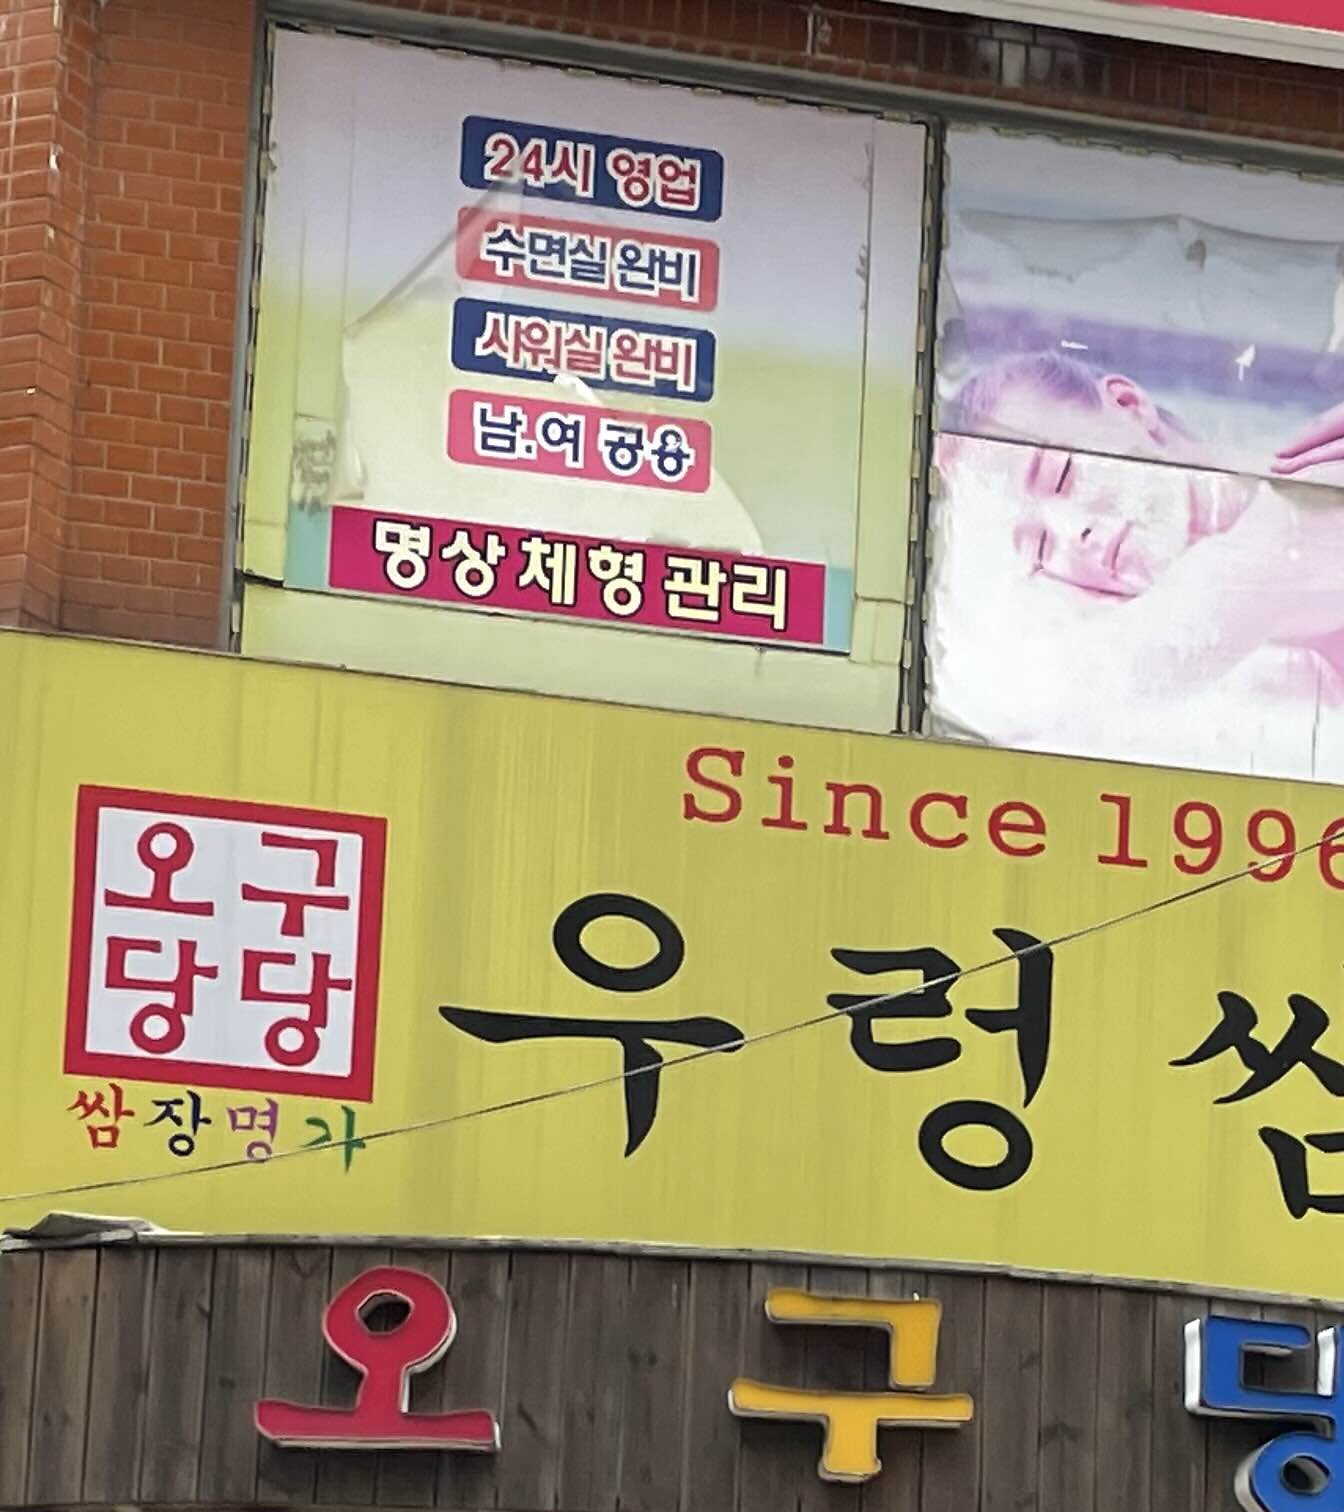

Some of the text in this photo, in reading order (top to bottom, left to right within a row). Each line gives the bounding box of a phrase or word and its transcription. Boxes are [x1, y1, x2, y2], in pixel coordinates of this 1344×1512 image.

[485, 139, 699, 206] 24시 영업
[485, 224, 697, 297] 수면실 완비
[615, 335, 693, 391] 완비
[476, 406, 693, 479] 남.여 공용
[682, 746, 1048, 857] Since
[66, 1083, 368, 1174] 쌈장명가
